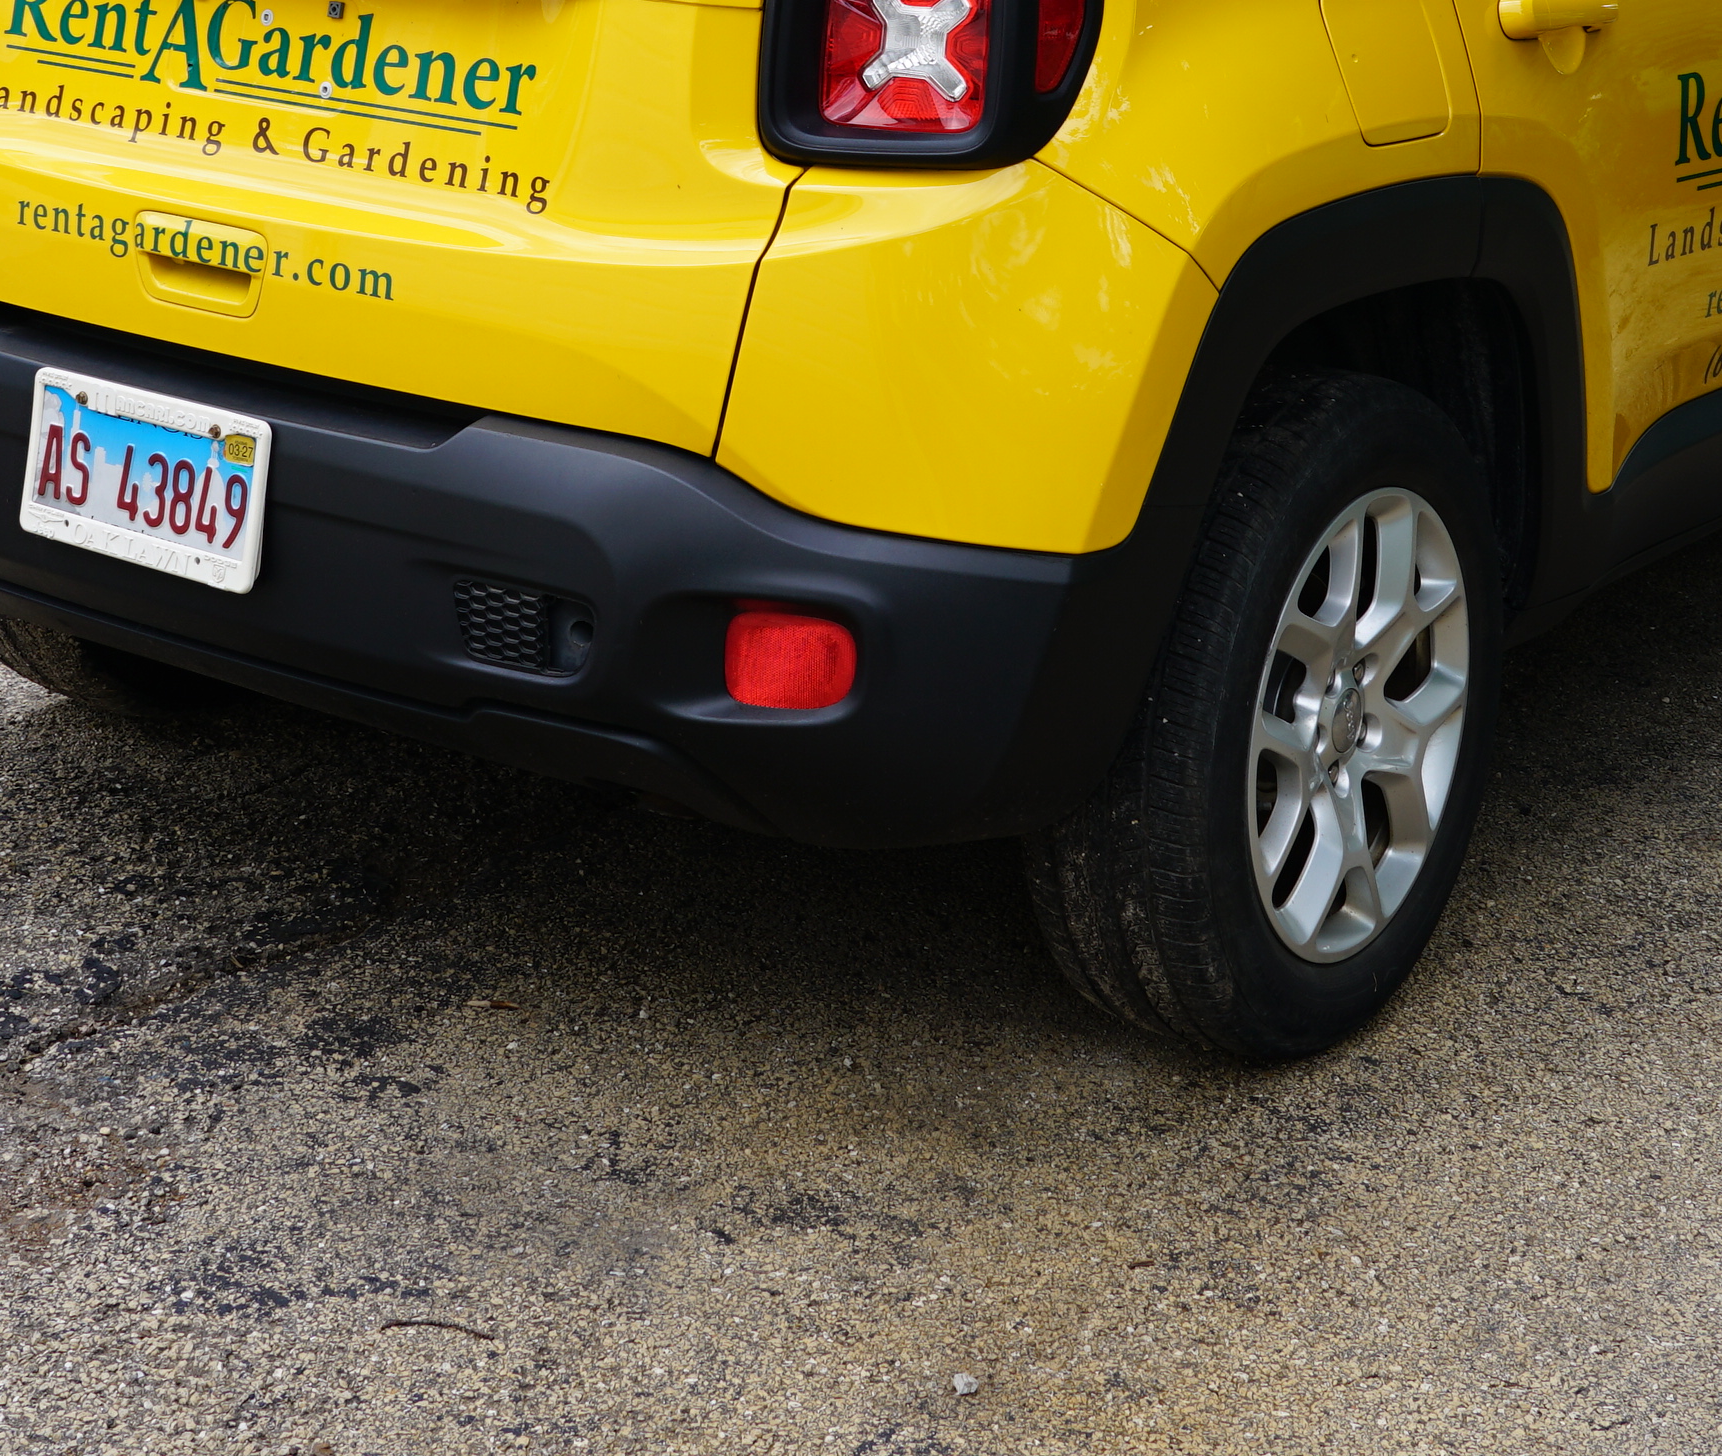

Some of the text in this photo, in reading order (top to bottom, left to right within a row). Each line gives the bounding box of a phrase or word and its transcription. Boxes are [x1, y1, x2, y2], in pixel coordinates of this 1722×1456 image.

[252, 117, 280, 157] &
[302, 126, 552, 216] Gardening
[16, 198, 396, 301] rentagardener.com
[37, 424, 249, 549] AS 43849
[228, 442, 254, 458] 03-27
